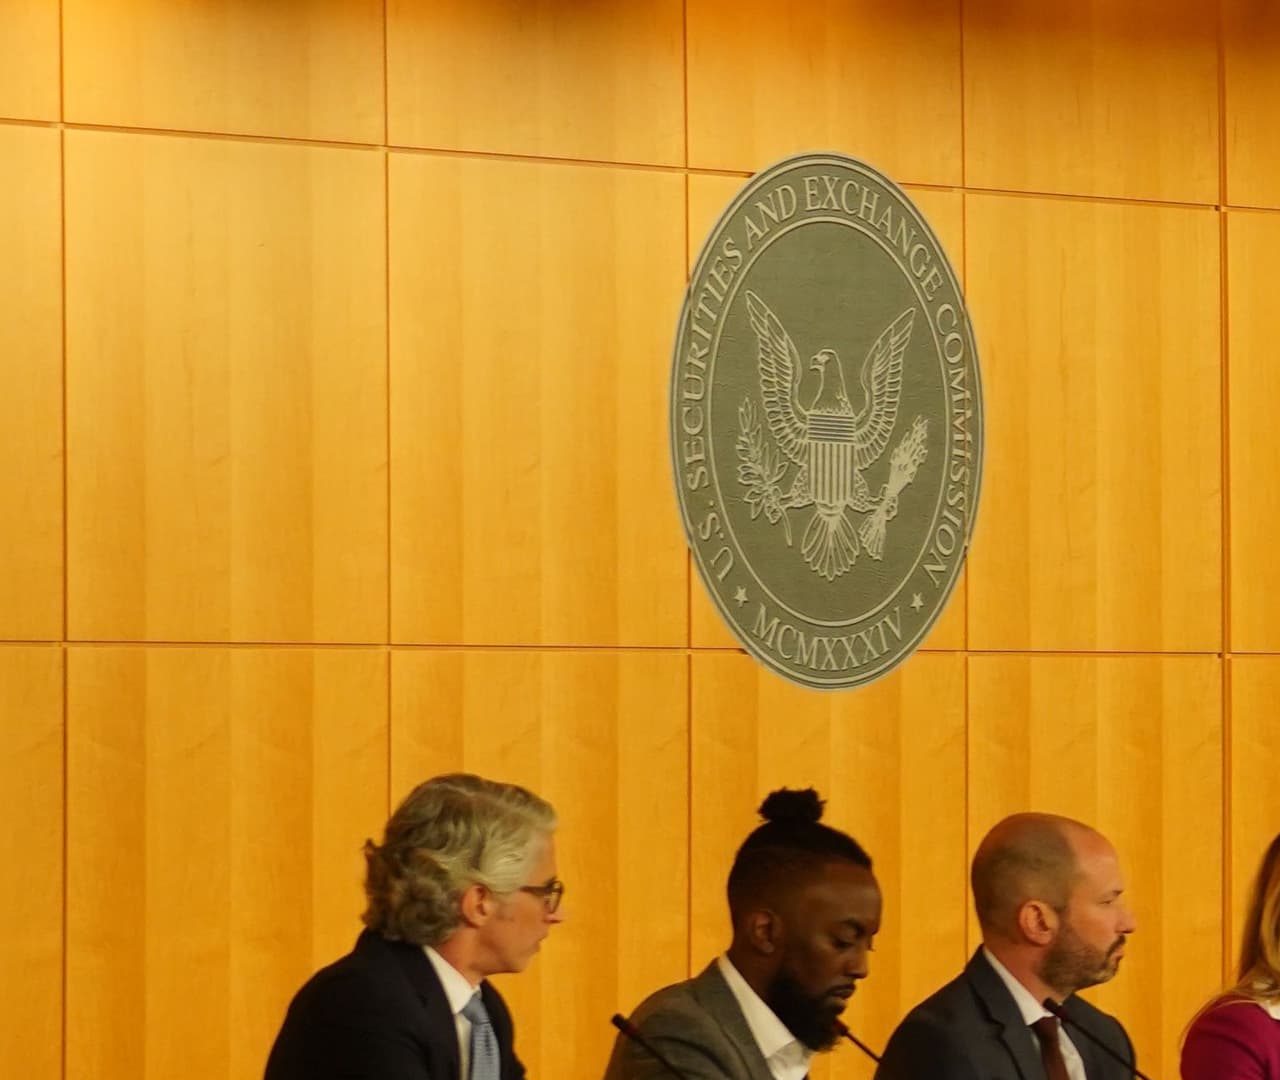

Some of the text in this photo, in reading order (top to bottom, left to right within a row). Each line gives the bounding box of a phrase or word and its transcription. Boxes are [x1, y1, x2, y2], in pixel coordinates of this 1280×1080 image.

[681, 174, 973, 588] U.S. SECURITIES AND EXCHANGE COMMISSION
[751, 603, 904, 672] MCMXXXIV
